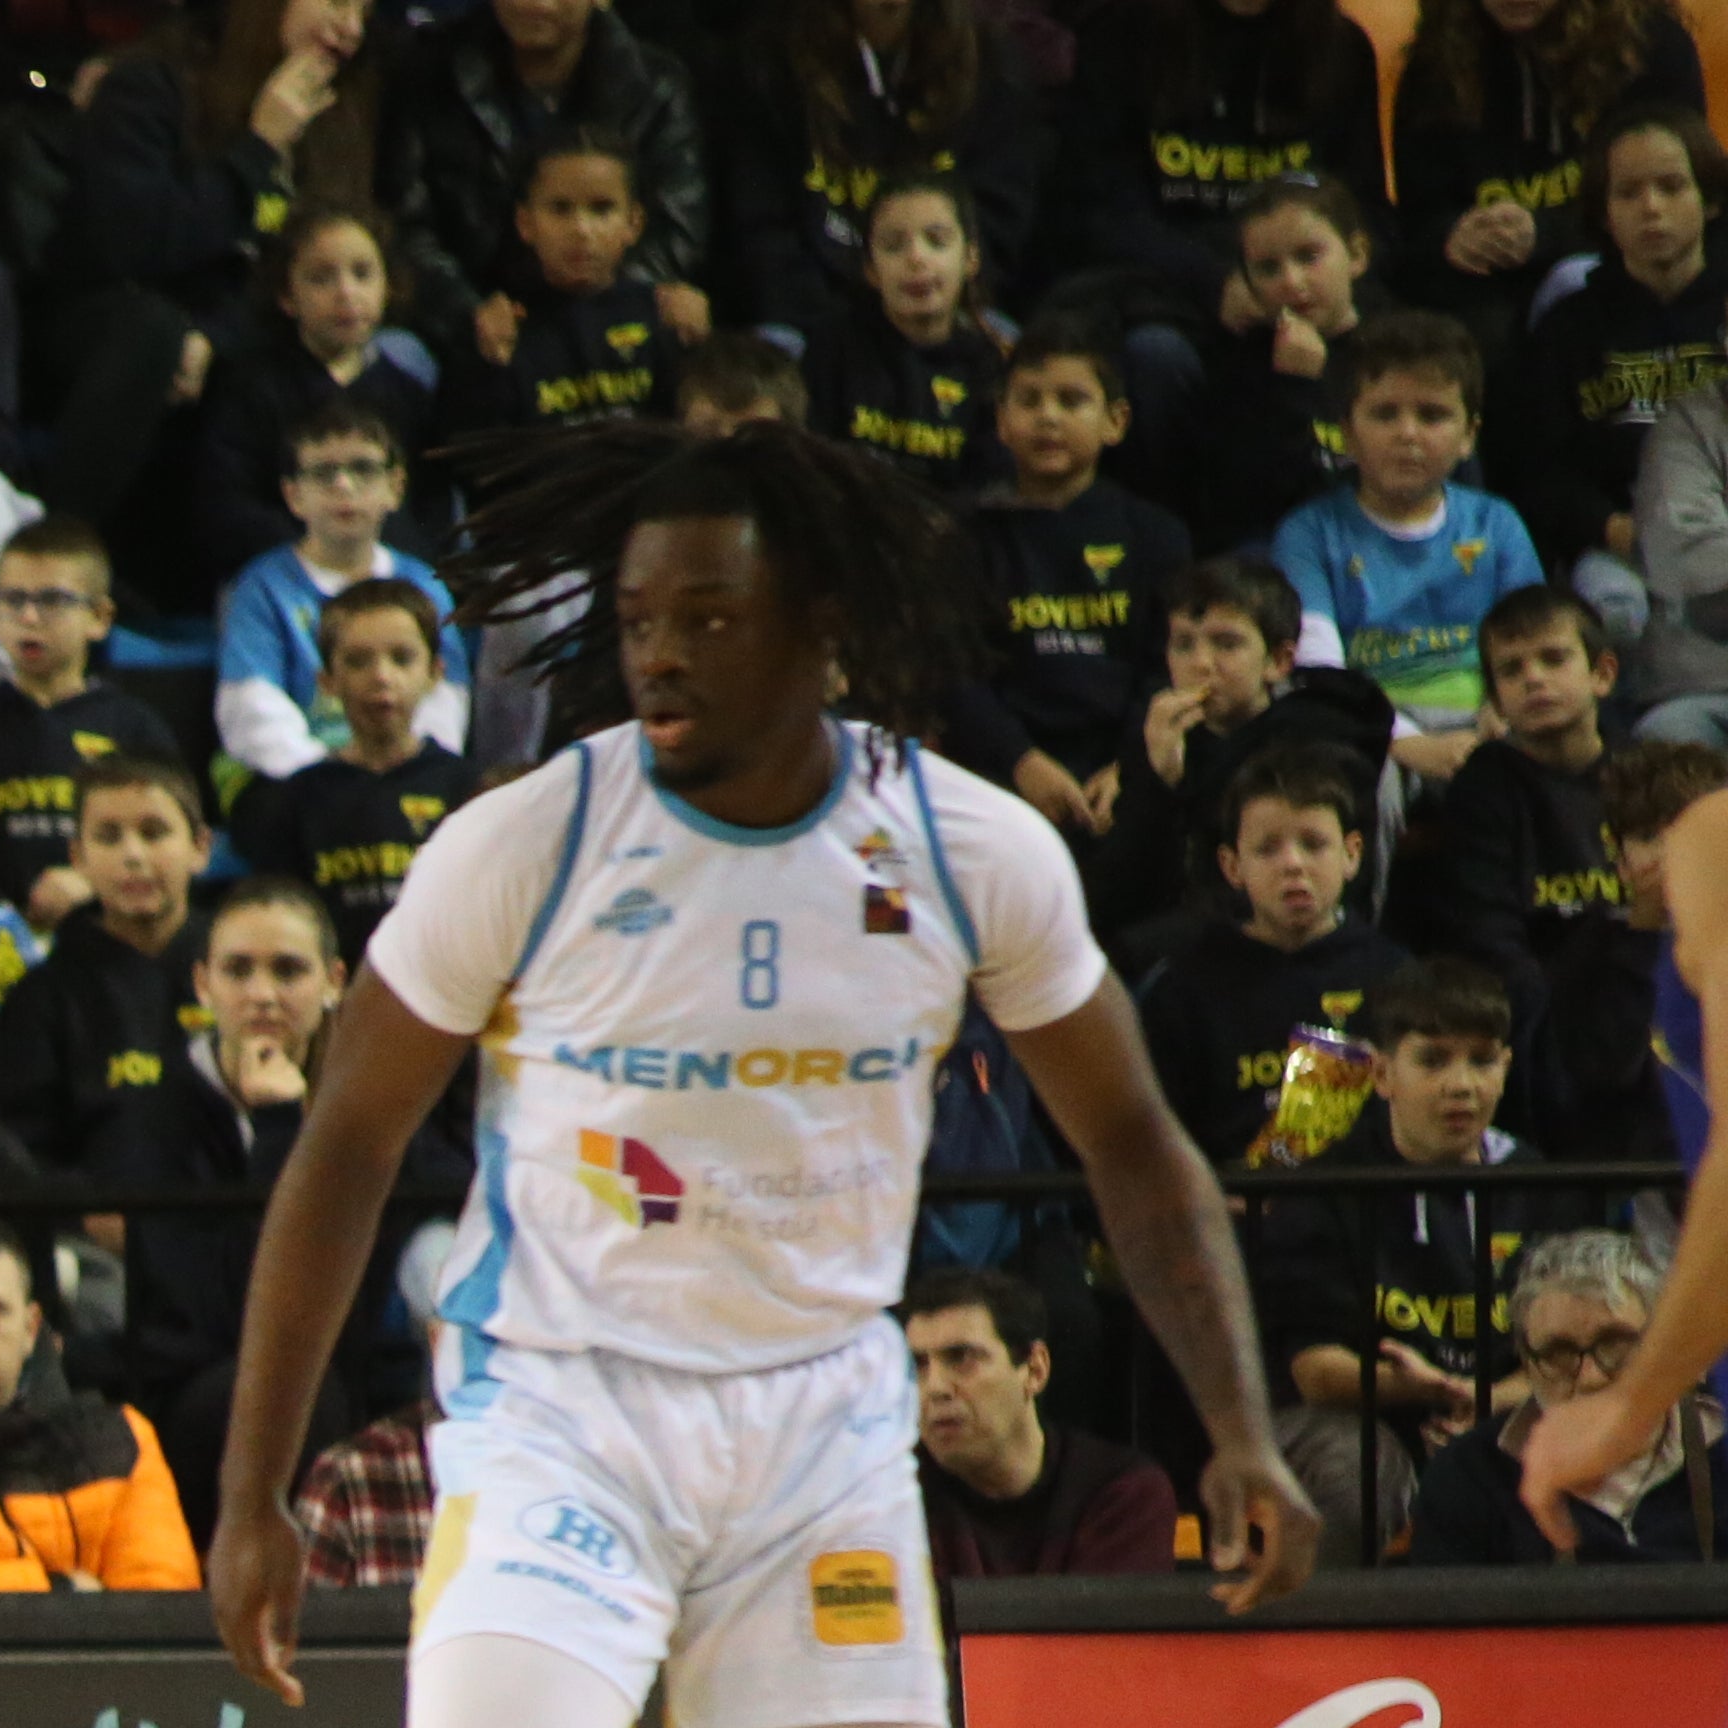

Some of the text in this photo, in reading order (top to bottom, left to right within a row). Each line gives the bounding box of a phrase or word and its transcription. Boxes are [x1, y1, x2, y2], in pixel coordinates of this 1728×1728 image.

[1008, 589, 1130, 633] JOVENT
[739, 919, 781, 1011] 8
[553, 1036, 920, 1091] MENORC
